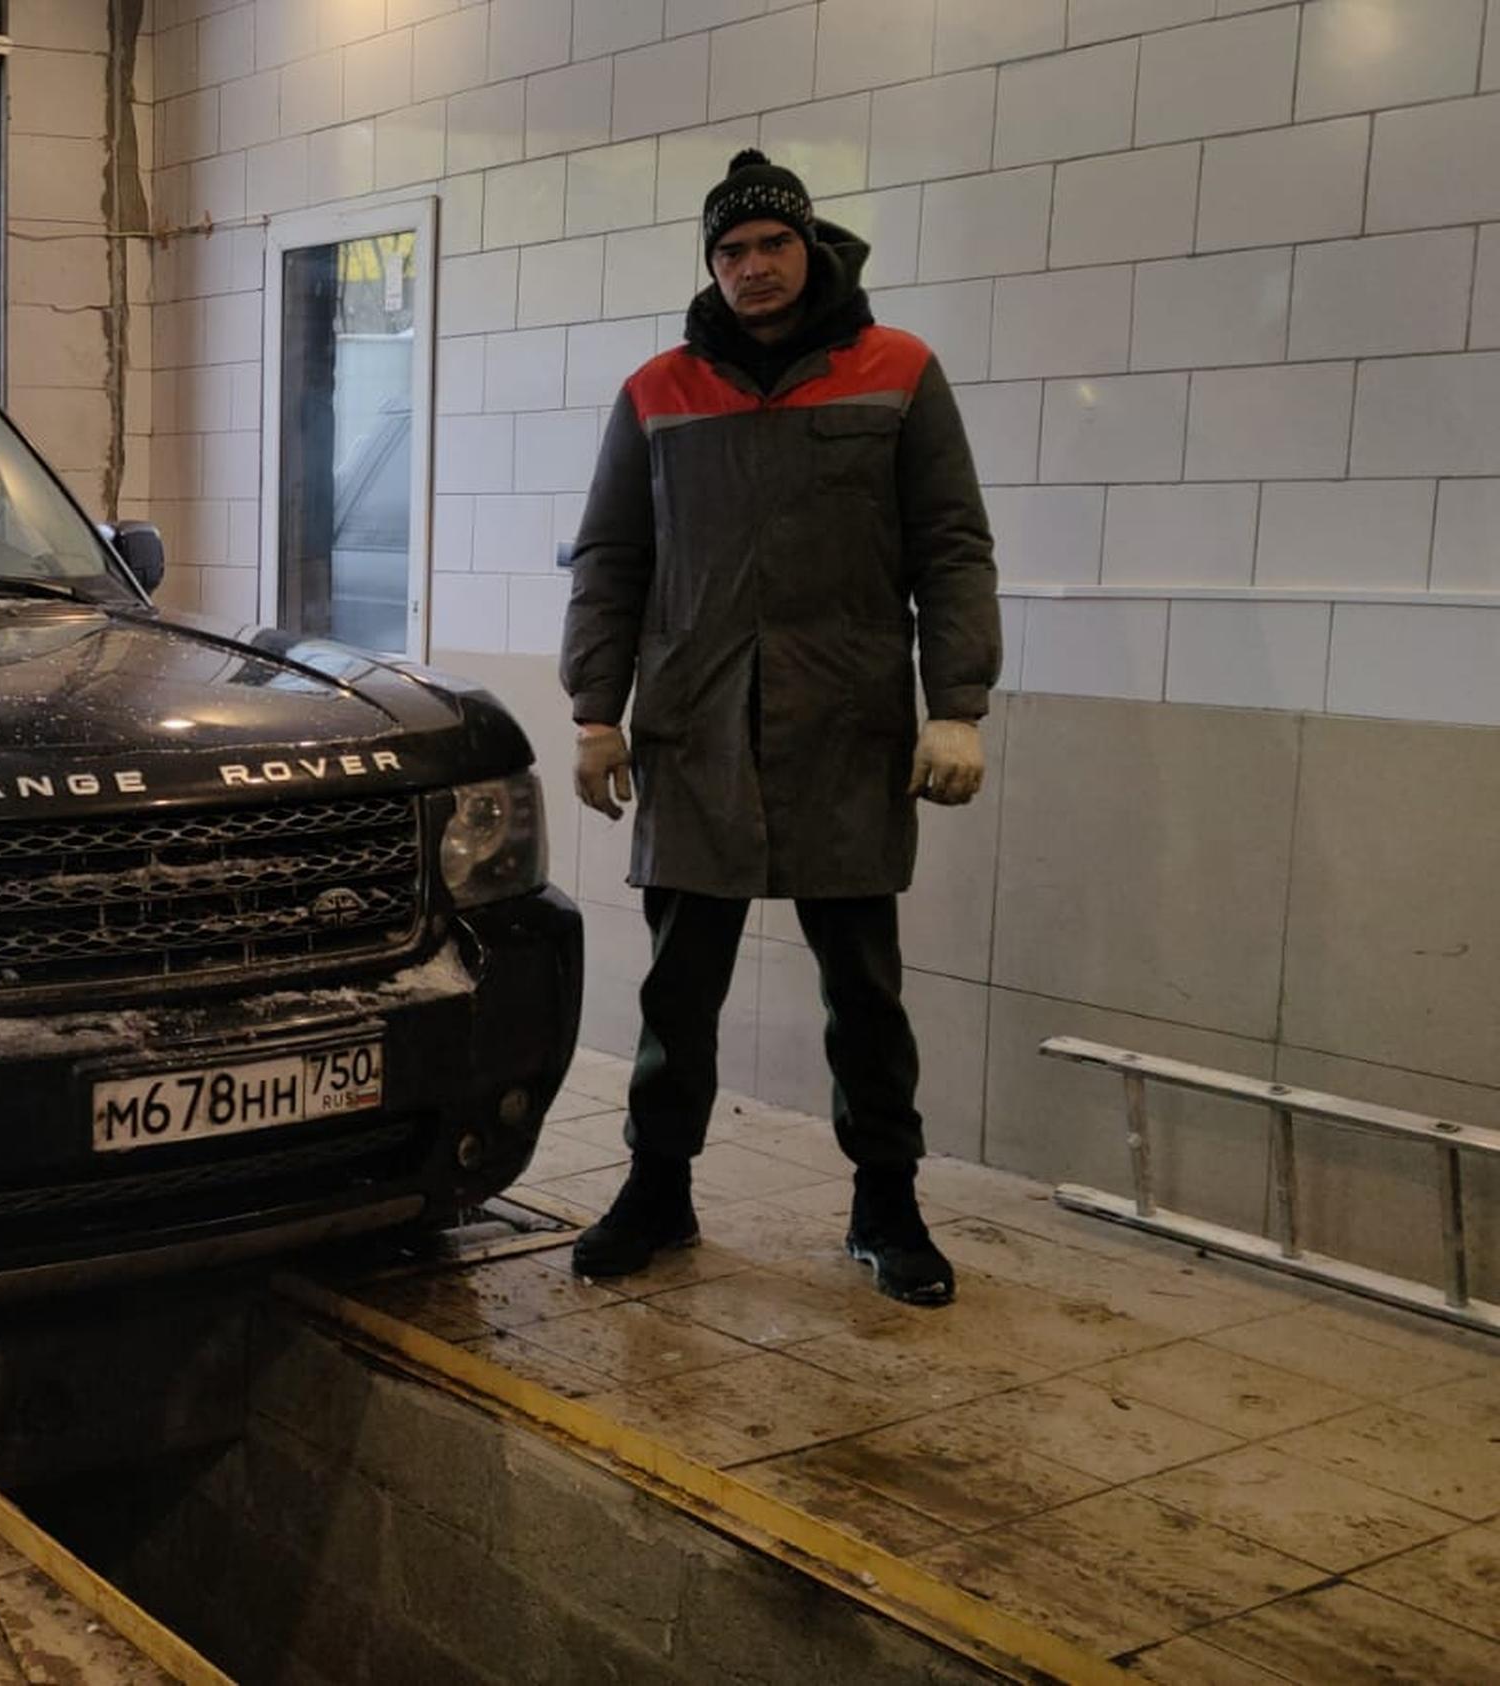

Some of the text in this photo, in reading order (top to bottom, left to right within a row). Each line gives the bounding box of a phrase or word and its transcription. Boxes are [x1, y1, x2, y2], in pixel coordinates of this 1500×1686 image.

[219, 751, 403, 787] ROVER
[309, 1047, 372, 1095] 750
[322, 1091, 355, 1110] RUS
